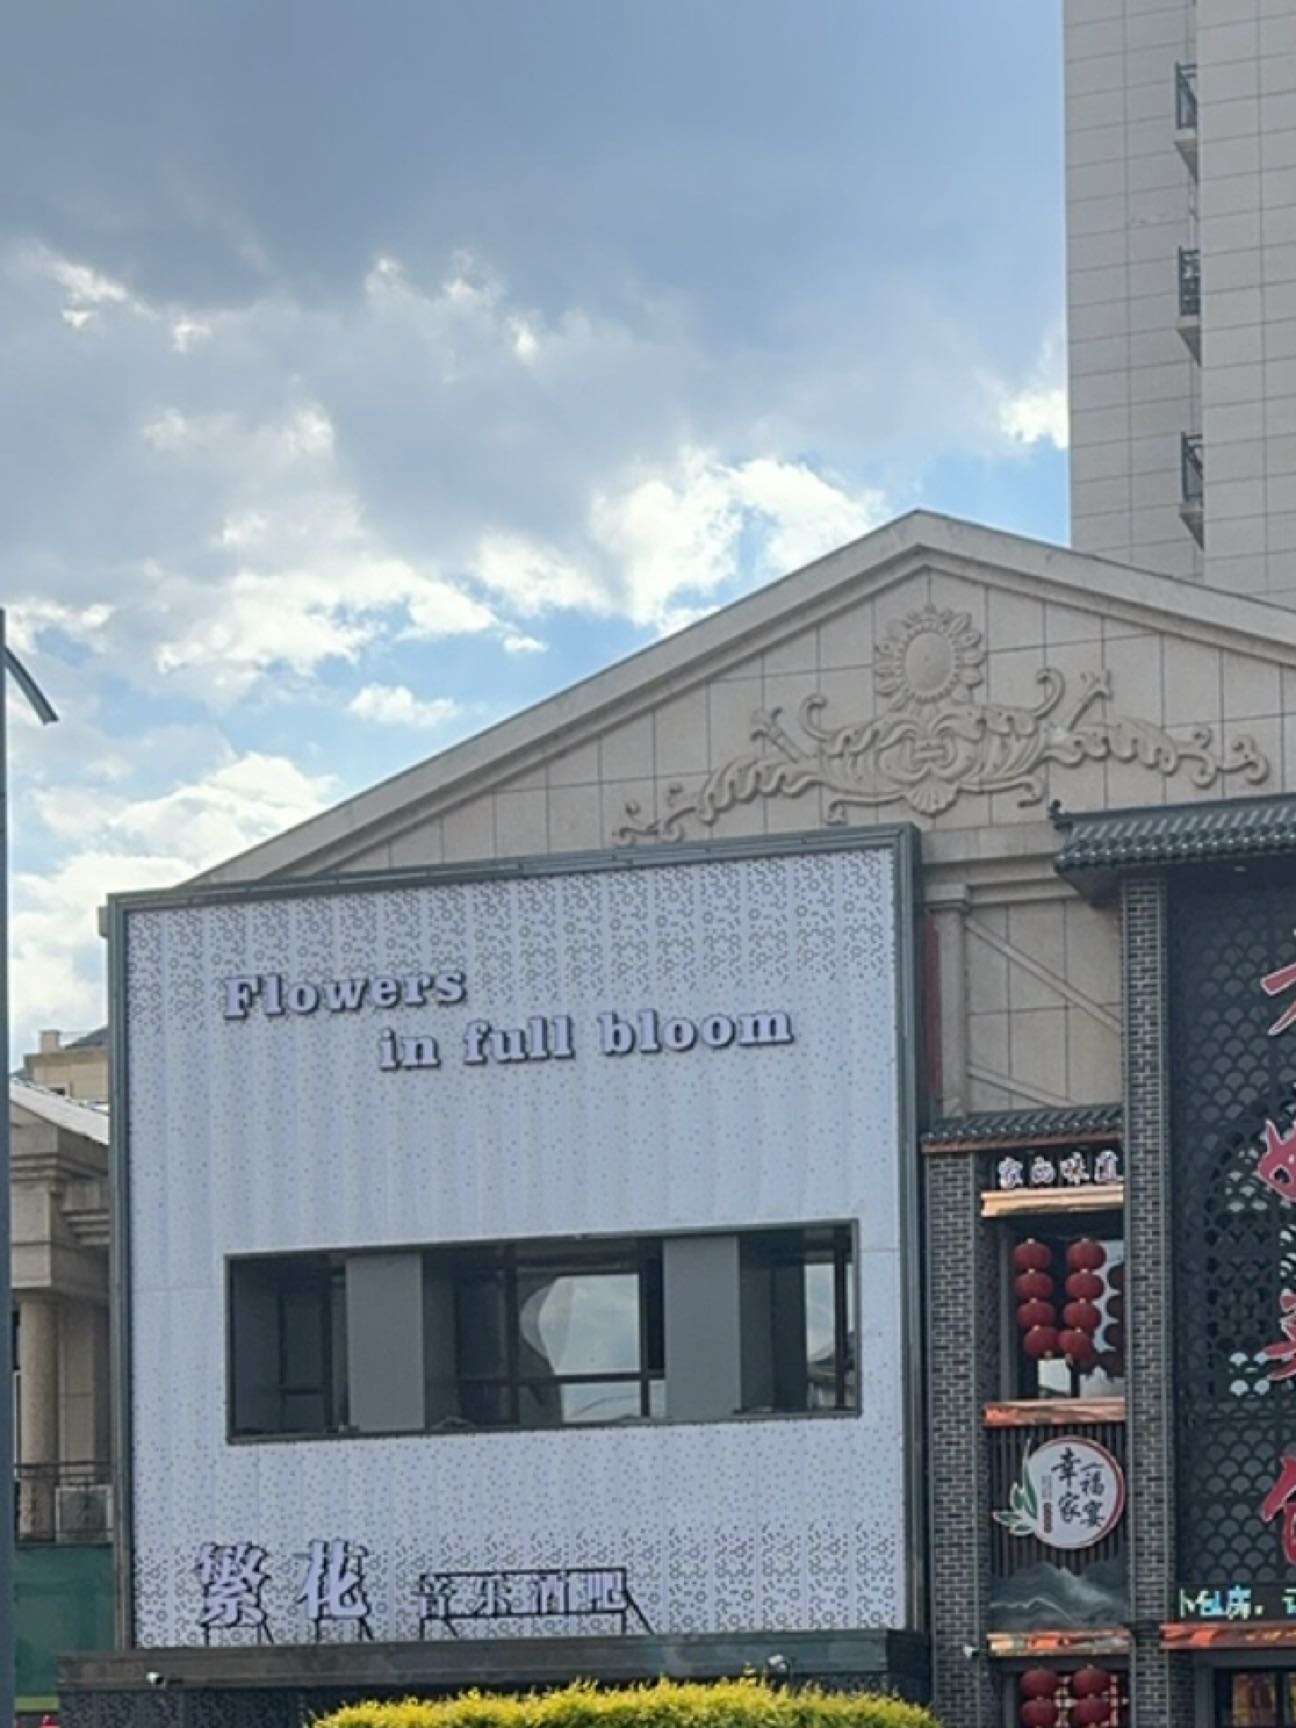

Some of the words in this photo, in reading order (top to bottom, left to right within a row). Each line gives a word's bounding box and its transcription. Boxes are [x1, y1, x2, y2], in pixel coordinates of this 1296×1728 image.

[222, 969, 468, 1019] Flowers
[378, 1028, 440, 1071] in
[462, 1016, 575, 1066] full
[599, 1008, 794, 1056] bloom
